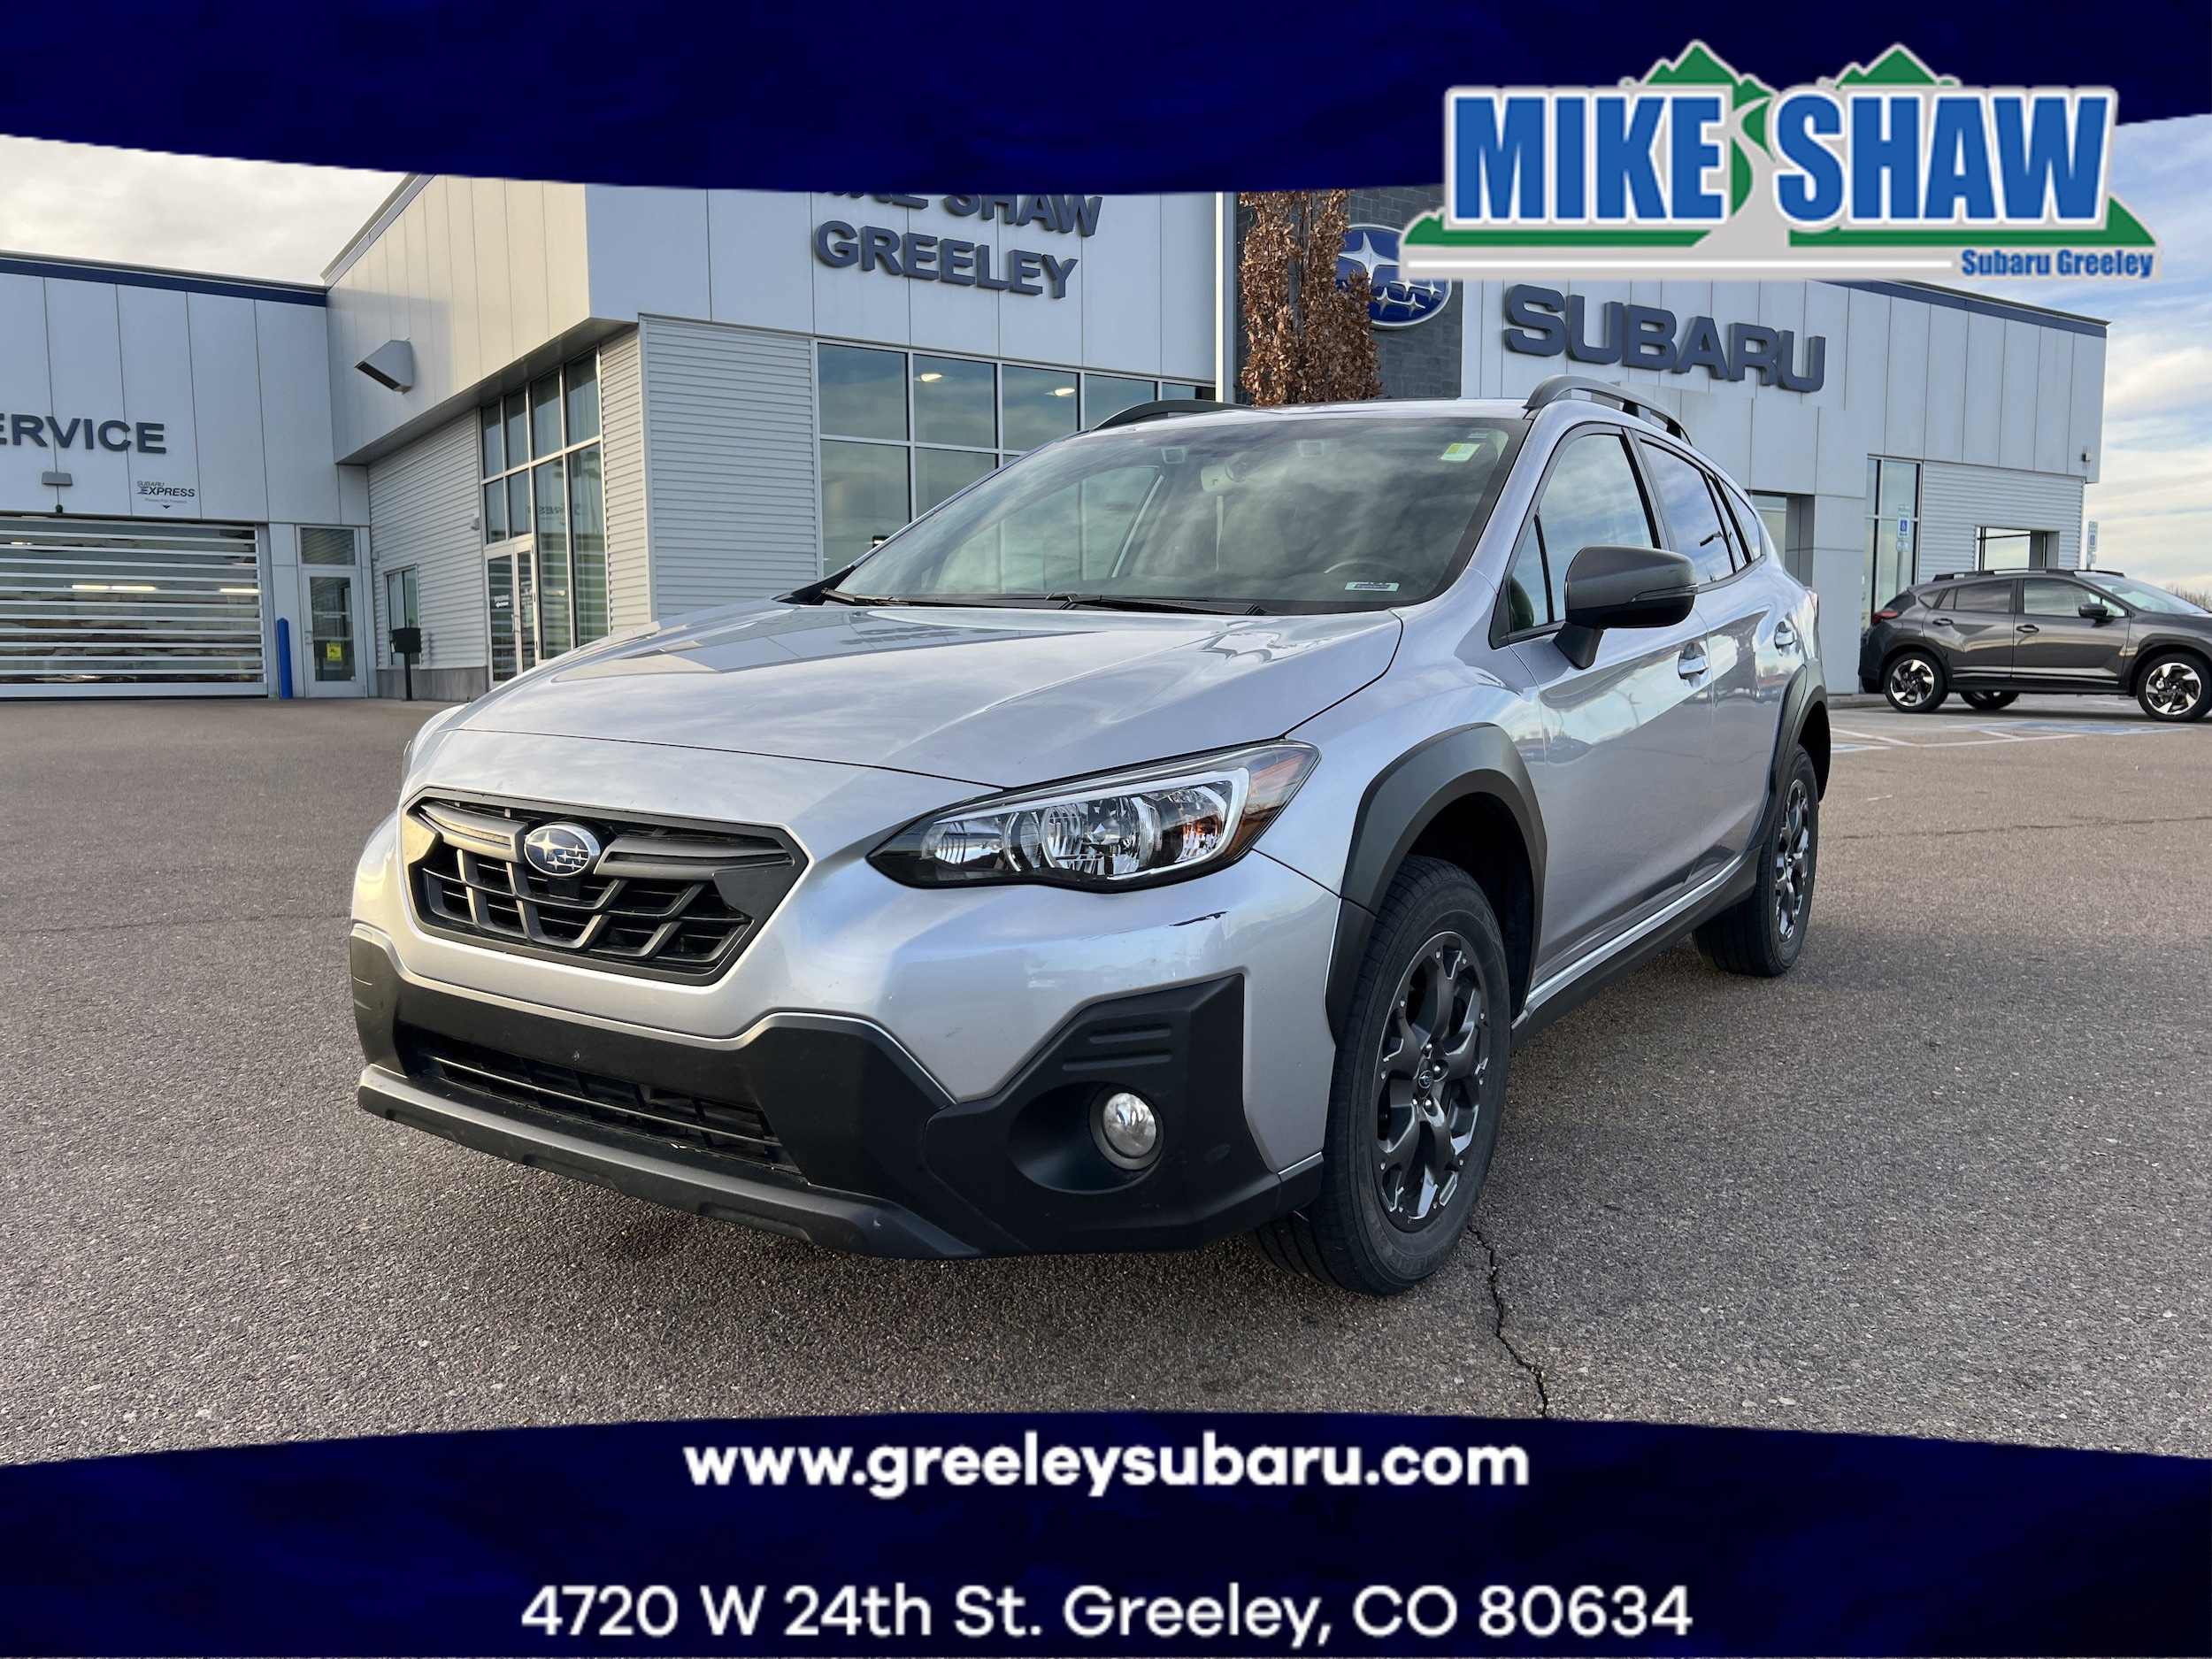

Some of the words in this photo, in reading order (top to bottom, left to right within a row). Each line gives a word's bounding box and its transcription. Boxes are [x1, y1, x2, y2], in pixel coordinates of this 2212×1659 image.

[813, 219, 1079, 300] GREELEY
[1503, 283, 1827, 395] SUBARU
[0, 412, 167, 455] RVICE
[136, 486, 196, 497] EXPRESS
